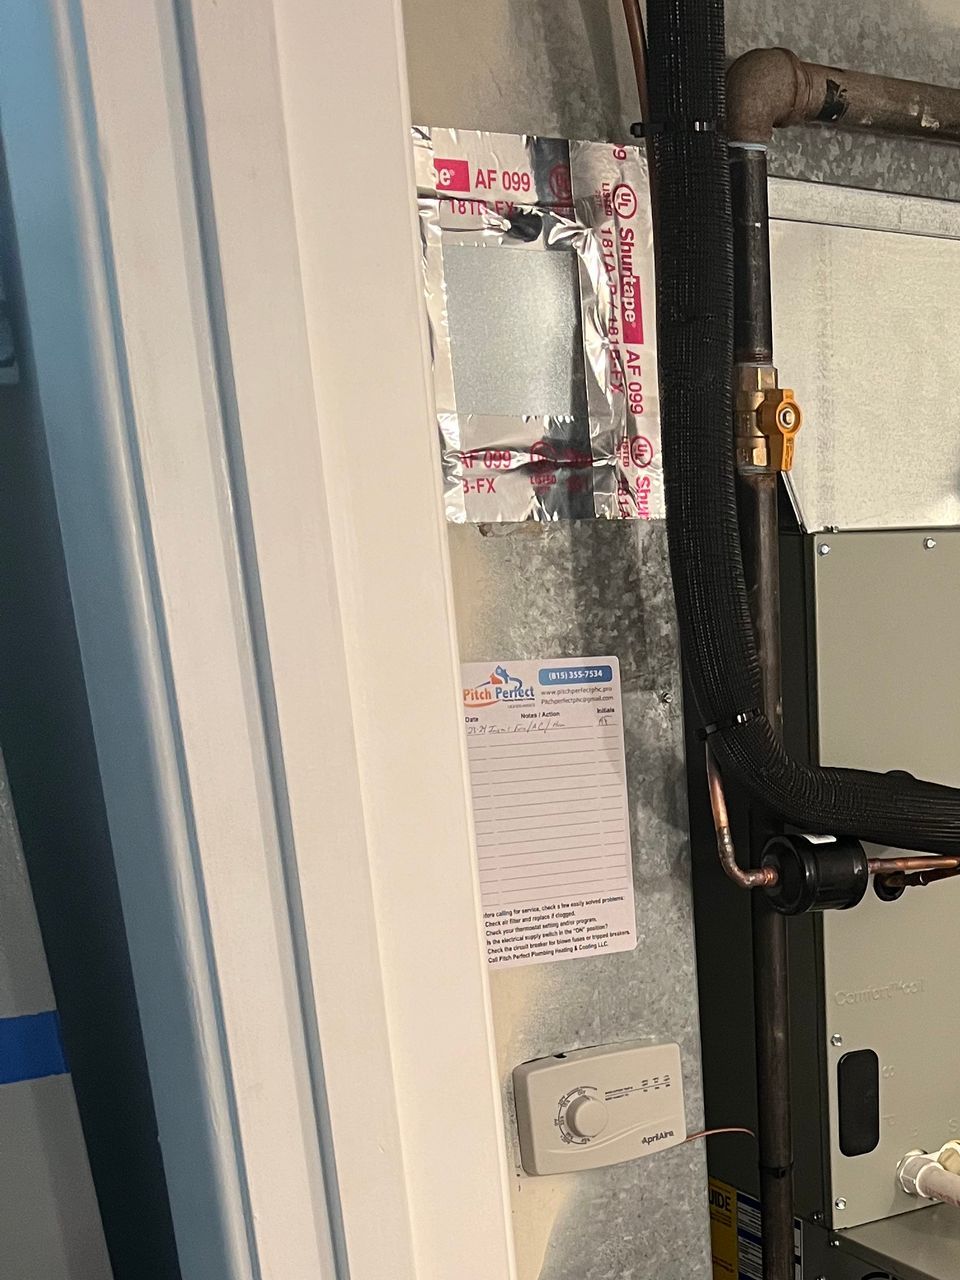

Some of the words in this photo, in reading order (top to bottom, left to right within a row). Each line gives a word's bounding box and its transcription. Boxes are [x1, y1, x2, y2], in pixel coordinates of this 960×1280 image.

[475, 168, 497, 189] AF
[502, 170, 531, 192] 099
[620, 227, 637, 322] Shurtape
[626, 349, 642, 377] AF
[628, 382, 644, 415] 099
[483, 449, 512, 469] 099
[548, 669, 568, 682] (815)
[463, 688, 492, 701] Pitch
[495, 686, 535, 701] Perfect
[465, 716, 479, 724] Date
[641, 1130, 675, 1146] AprilAire
